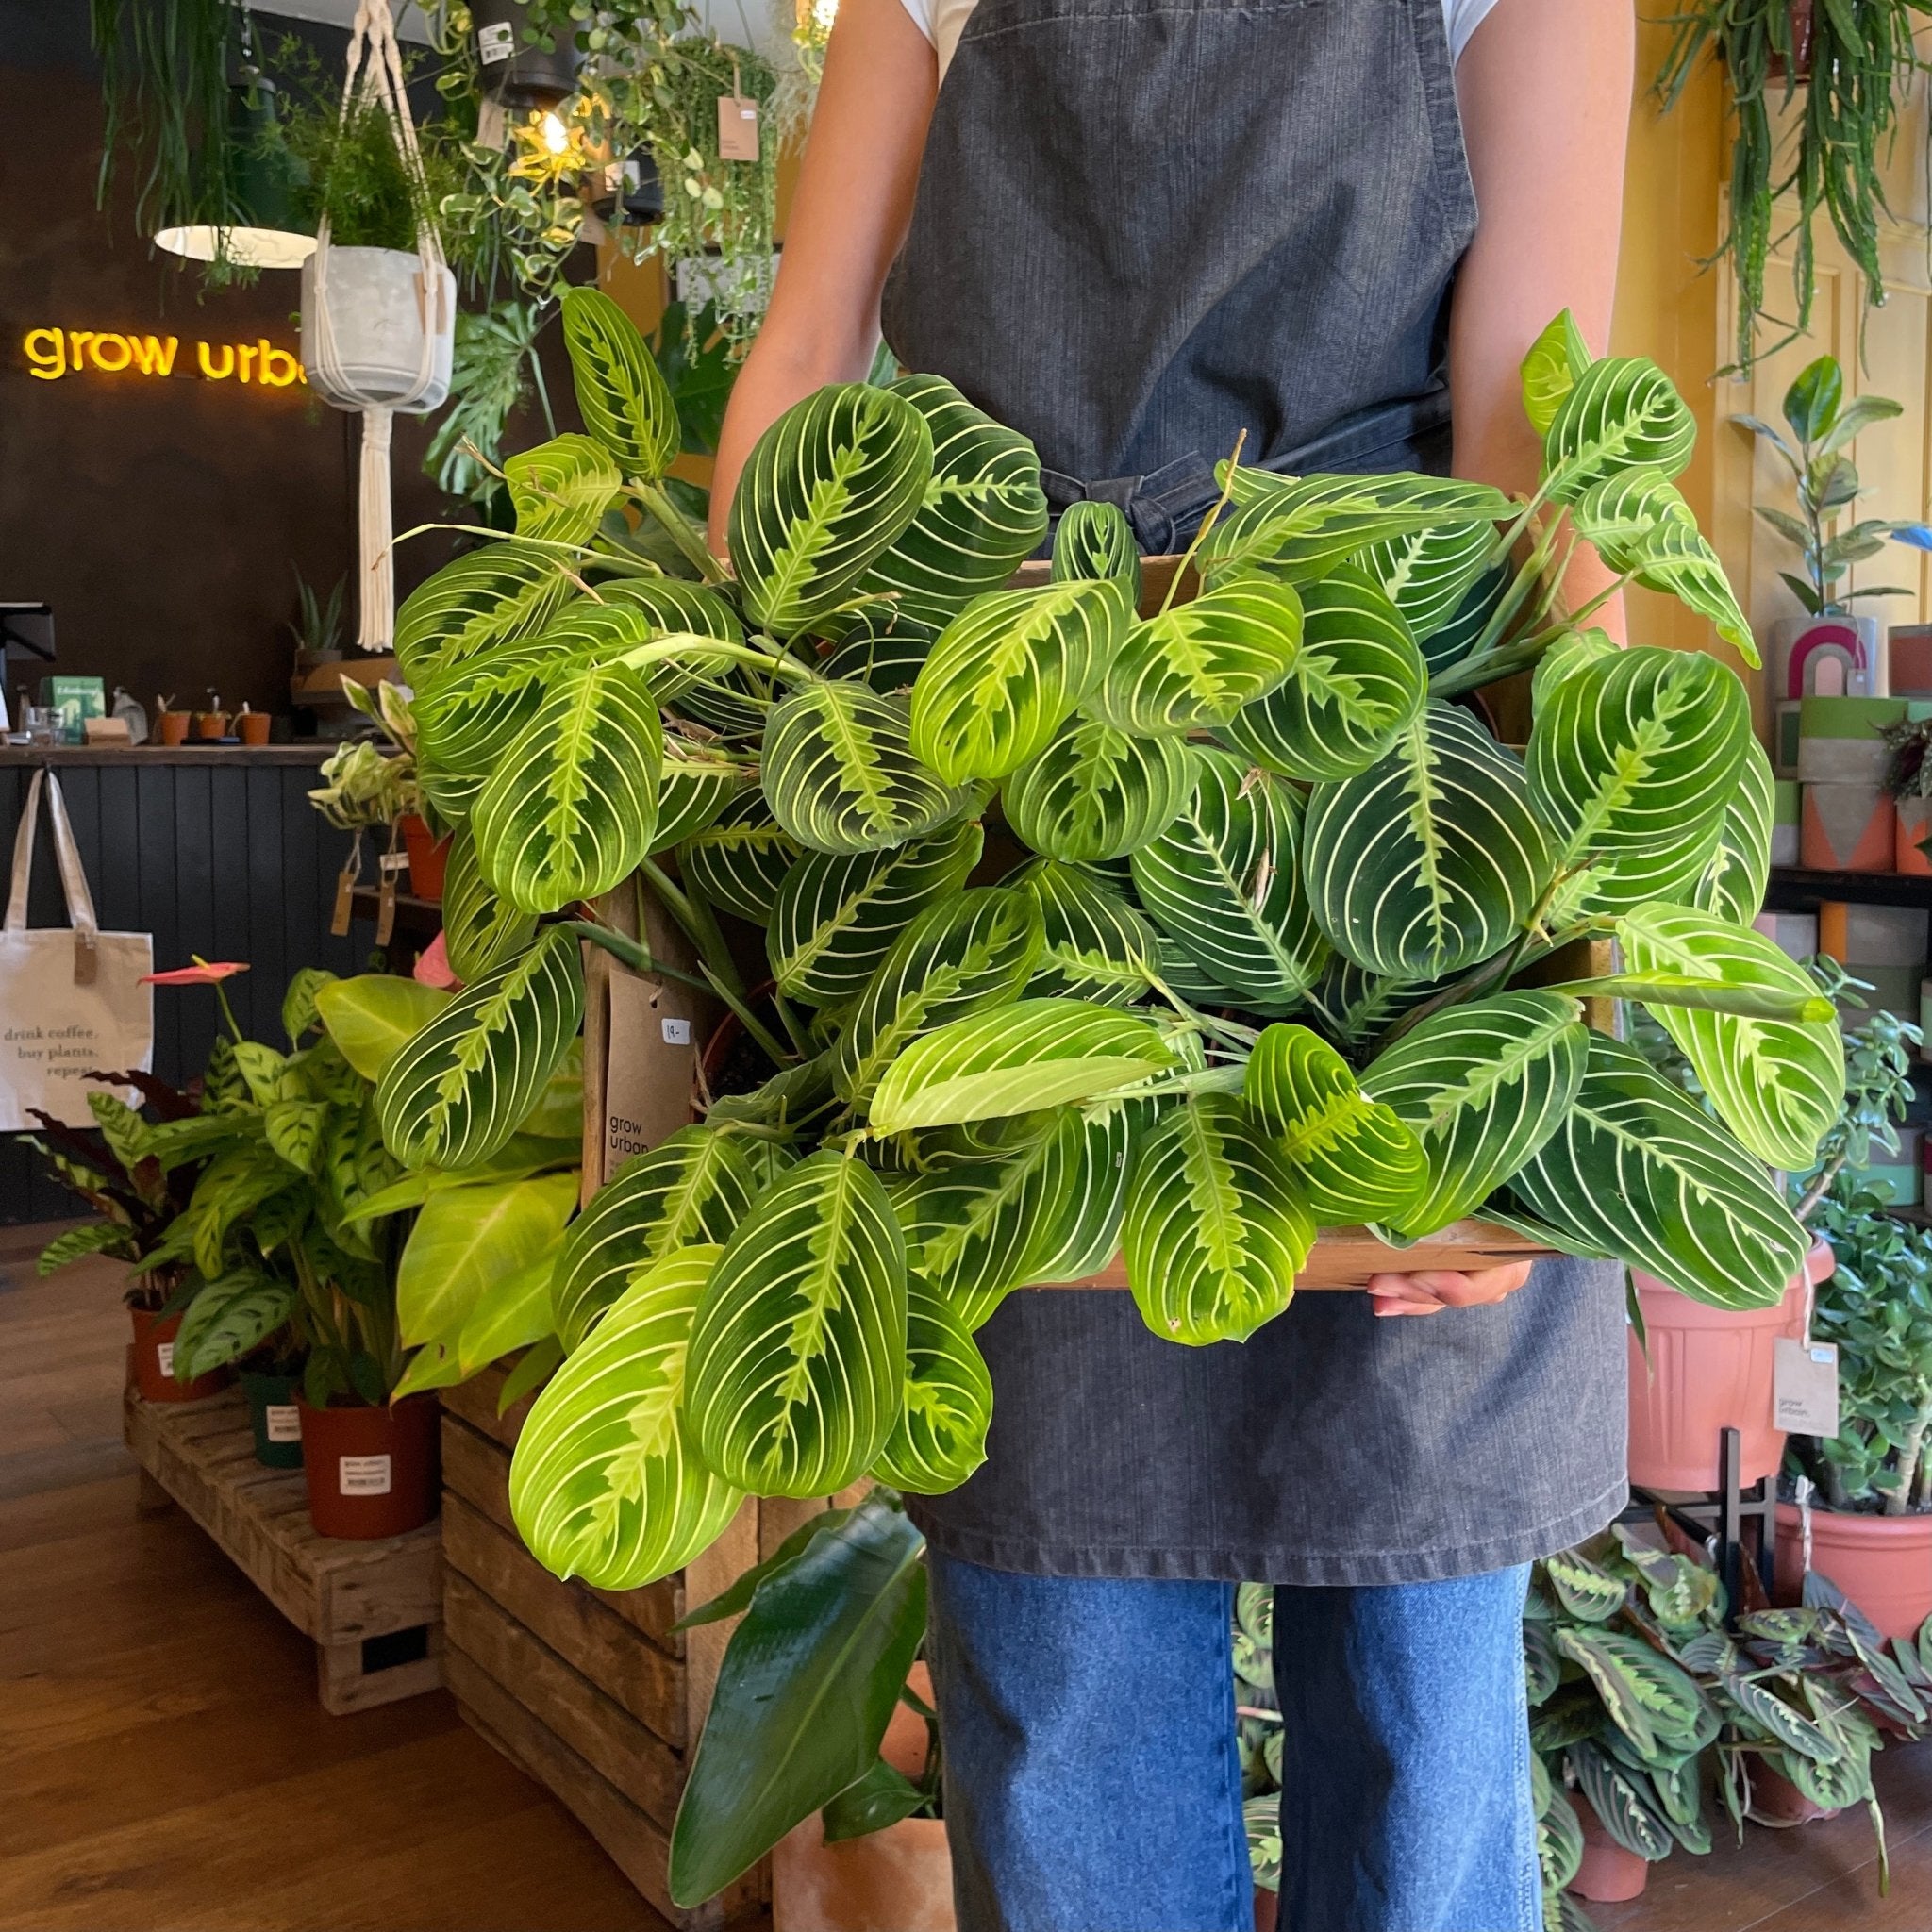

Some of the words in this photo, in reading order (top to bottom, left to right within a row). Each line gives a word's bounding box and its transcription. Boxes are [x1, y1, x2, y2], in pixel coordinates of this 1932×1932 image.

[25, 327, 178, 379] grow
[198, 338, 308, 386] urb
[4, 1025, 44, 1041] drink
[47, 1024, 99, 1039] coffee.
[17, 1046, 44, 1060] buy
[609, 1116, 642, 1135] grow
[610, 1135, 649, 1155] urban
